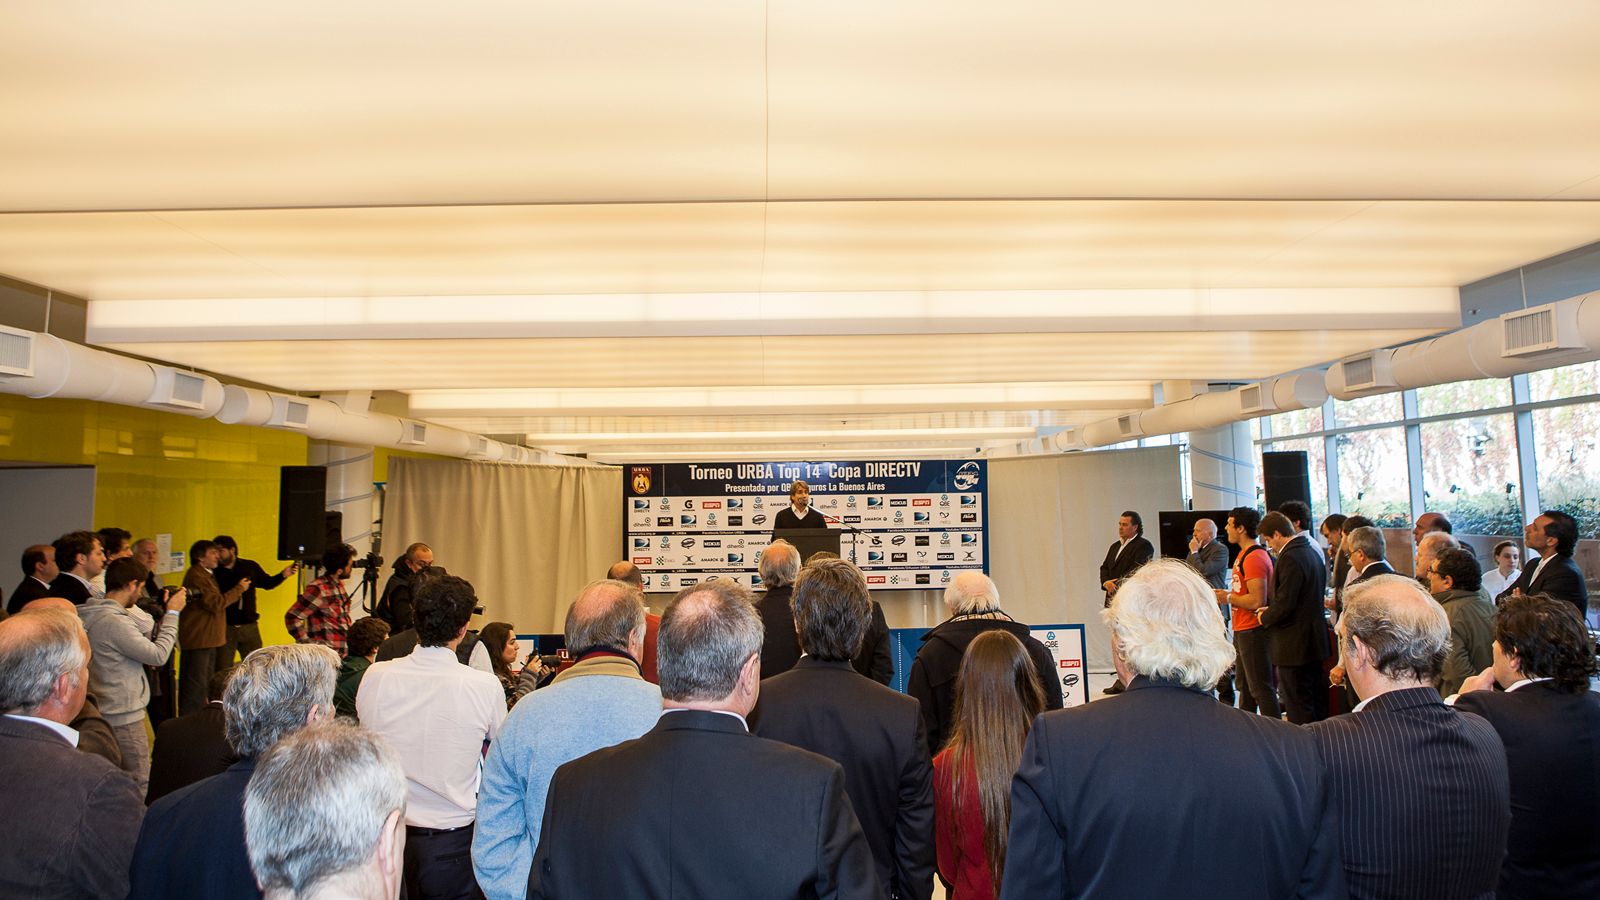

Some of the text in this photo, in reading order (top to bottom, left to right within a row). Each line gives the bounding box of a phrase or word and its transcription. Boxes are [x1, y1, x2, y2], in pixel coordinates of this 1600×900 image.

[688, 461, 921, 482] Torneo URBA Top 14 Copa DIRECTV
[725, 483, 766, 493] Presentada
[767, 484, 780, 494] por
[781, 482, 792, 493] QB
[828, 482, 837, 492] La
[839, 482, 865, 492] Buenos
[867, 481, 886, 491] Aires
[1045, 640, 1059, 648] QBE
